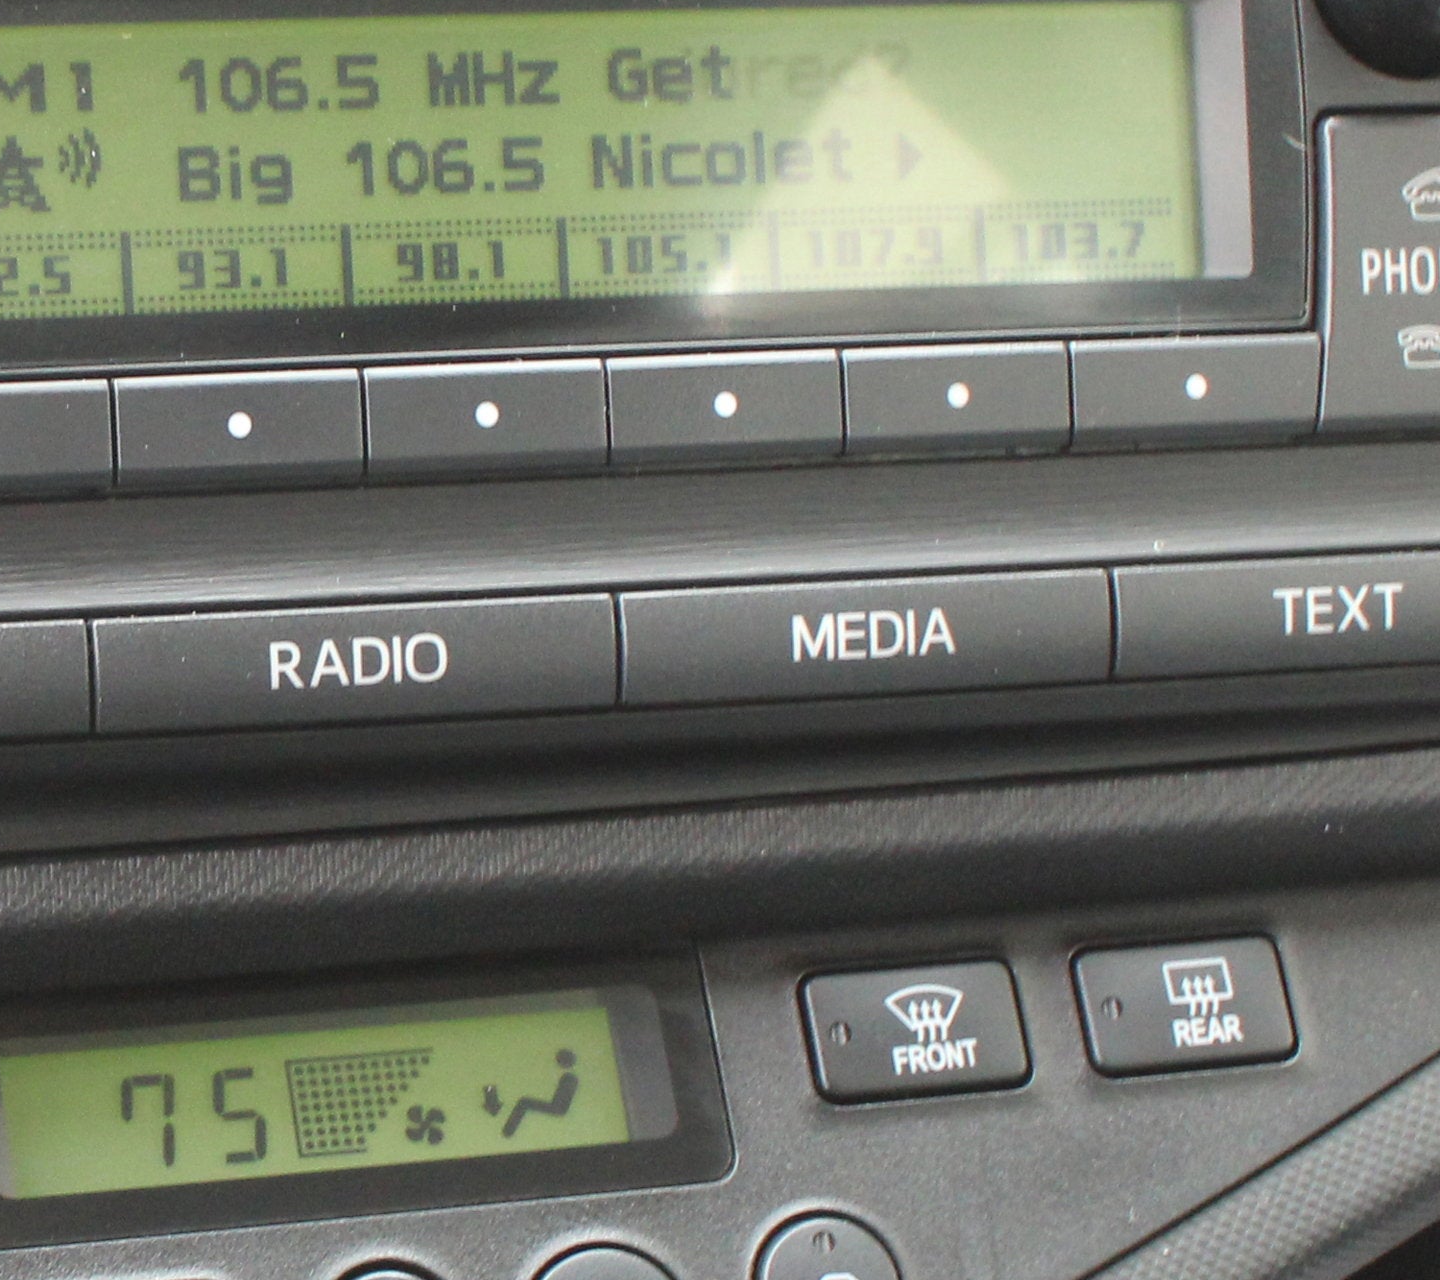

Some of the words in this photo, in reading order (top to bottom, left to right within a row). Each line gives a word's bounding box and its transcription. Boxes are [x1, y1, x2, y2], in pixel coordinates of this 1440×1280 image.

[177, 53, 380, 114] 106.5
[426, 49, 561, 108] MHz
[177, 144, 294, 205] Big
[345, 135, 546, 197] 106.5
[590, 128, 854, 190] Nicolet
[176, 246, 289, 291] 93.1
[396, 239, 506, 282] 98.1
[1013, 220, 1147, 264] 103.7
[790, 606, 957, 664] MEDIA
[1272, 581, 1405, 639] TEXT
[267, 631, 450, 691] RADIO
[891, 1037, 979, 1077] FRONT
[1170, 1014, 1245, 1049] REAR
[119, 1066, 269, 1169] 75
